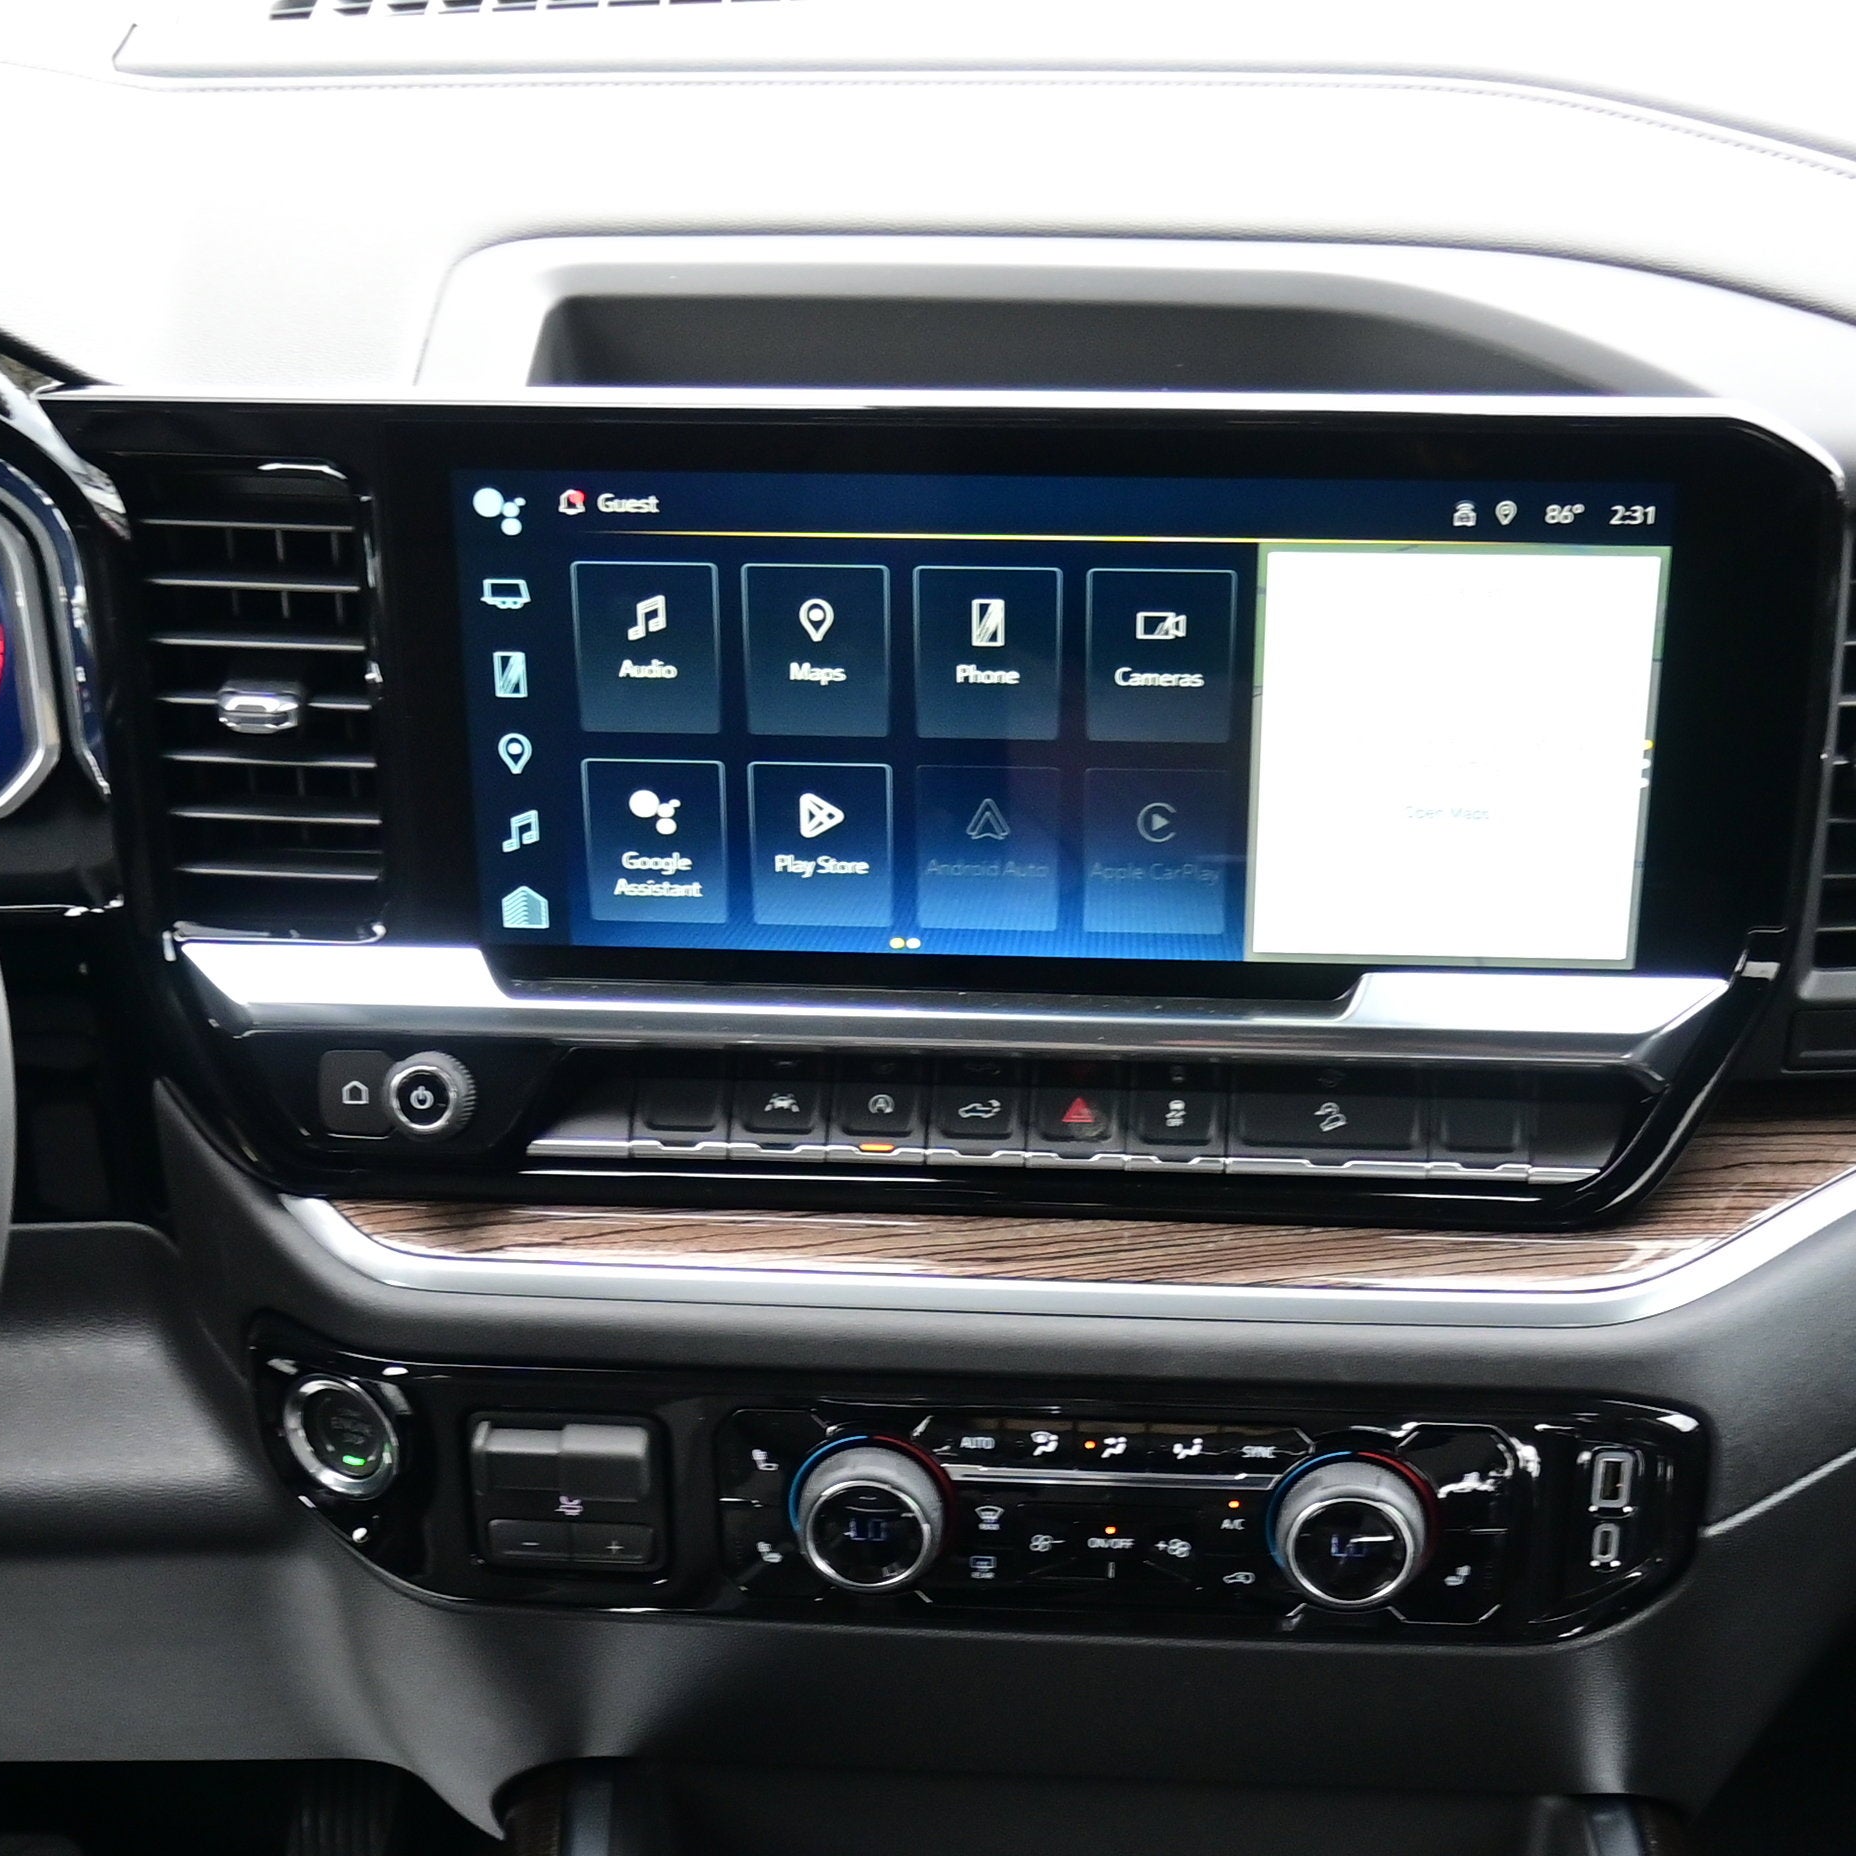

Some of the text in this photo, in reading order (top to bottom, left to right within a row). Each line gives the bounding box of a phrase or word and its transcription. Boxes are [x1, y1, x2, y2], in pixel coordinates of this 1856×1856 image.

[597, 493, 660, 515] Guest
[1544, 503, 1586, 525] 86°
[1608, 504, 1657, 526] 2:31
[619, 659, 678, 682] Audio
[789, 662, 846, 686] Maps
[955, 665, 1020, 687] Phone
[1114, 667, 1205, 690] Cameras
[621, 851, 692, 876] Google
[774, 854, 870, 879] Play Store
[927, 857, 1049, 878] Android Auto
[1090, 861, 1221, 886] Apple CarPlay
[614, 877, 703, 899] Assistant
[960, 1435, 996, 1450] AUTO
[1087, 1537, 1137, 1550] ON/OFF
